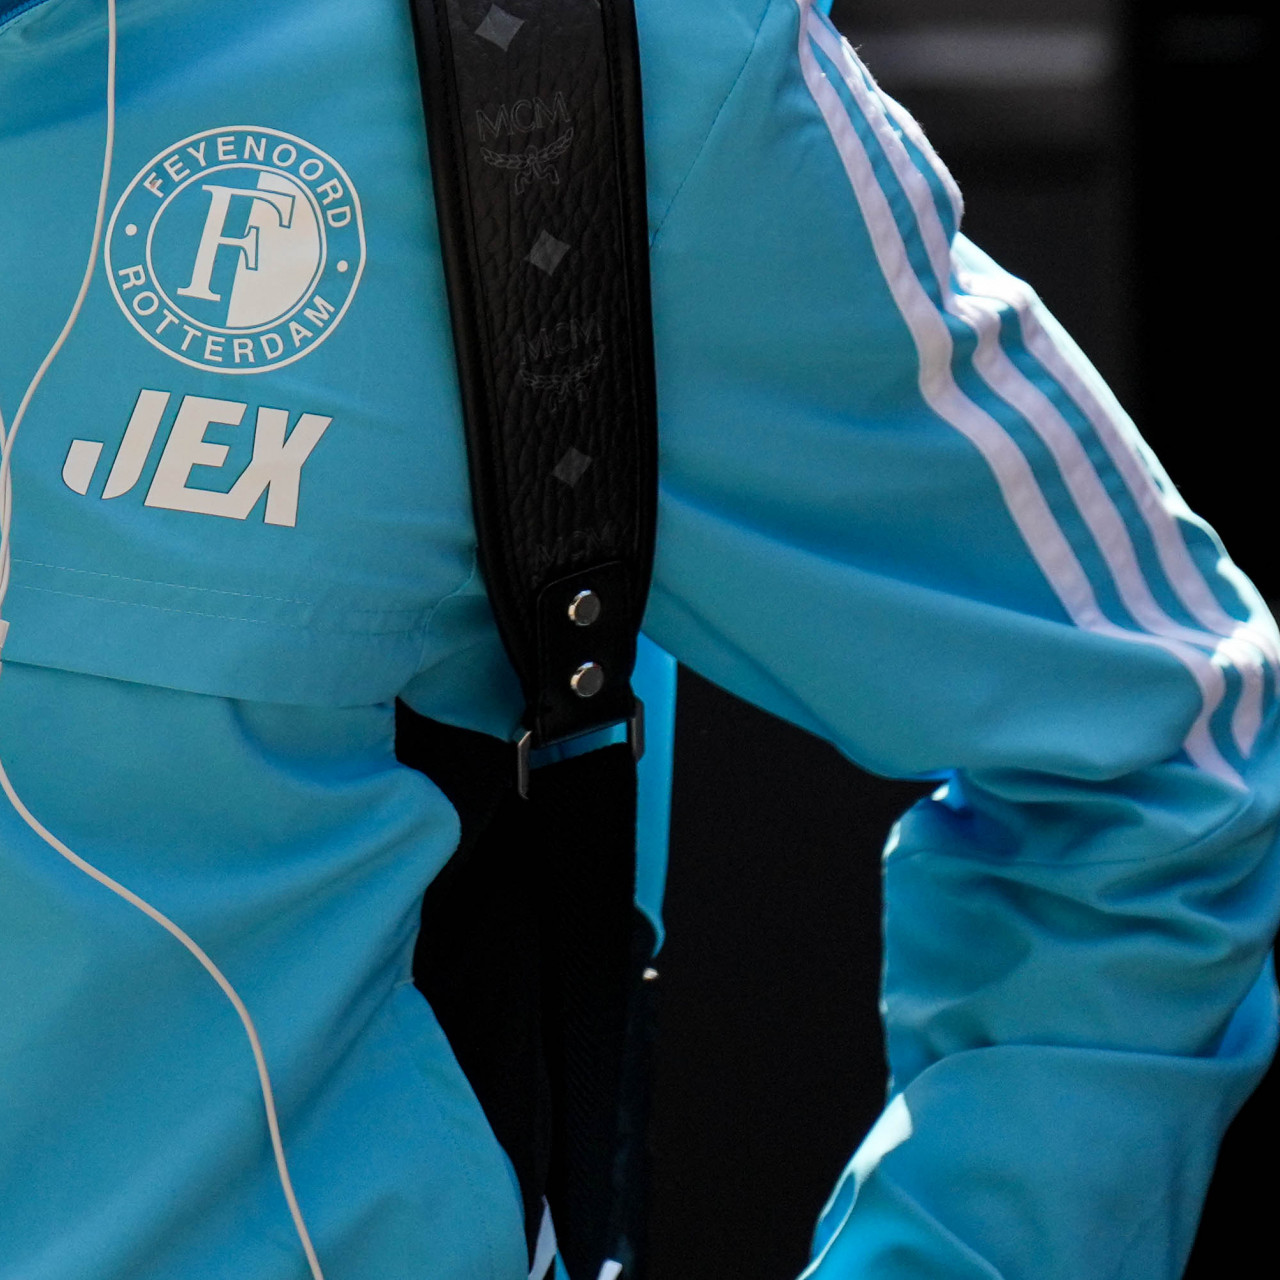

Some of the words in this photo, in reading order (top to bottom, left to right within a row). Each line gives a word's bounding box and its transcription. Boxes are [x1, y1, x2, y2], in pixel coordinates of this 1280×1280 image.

[475, 91, 572, 143] MCM
[143, 135, 352, 229] FEYENOORD
[176, 183, 296, 302] F
[118, 263, 336, 364] ROTTERDAM
[514, 313, 603, 365] MCM
[61, 388, 334, 528] JEX
